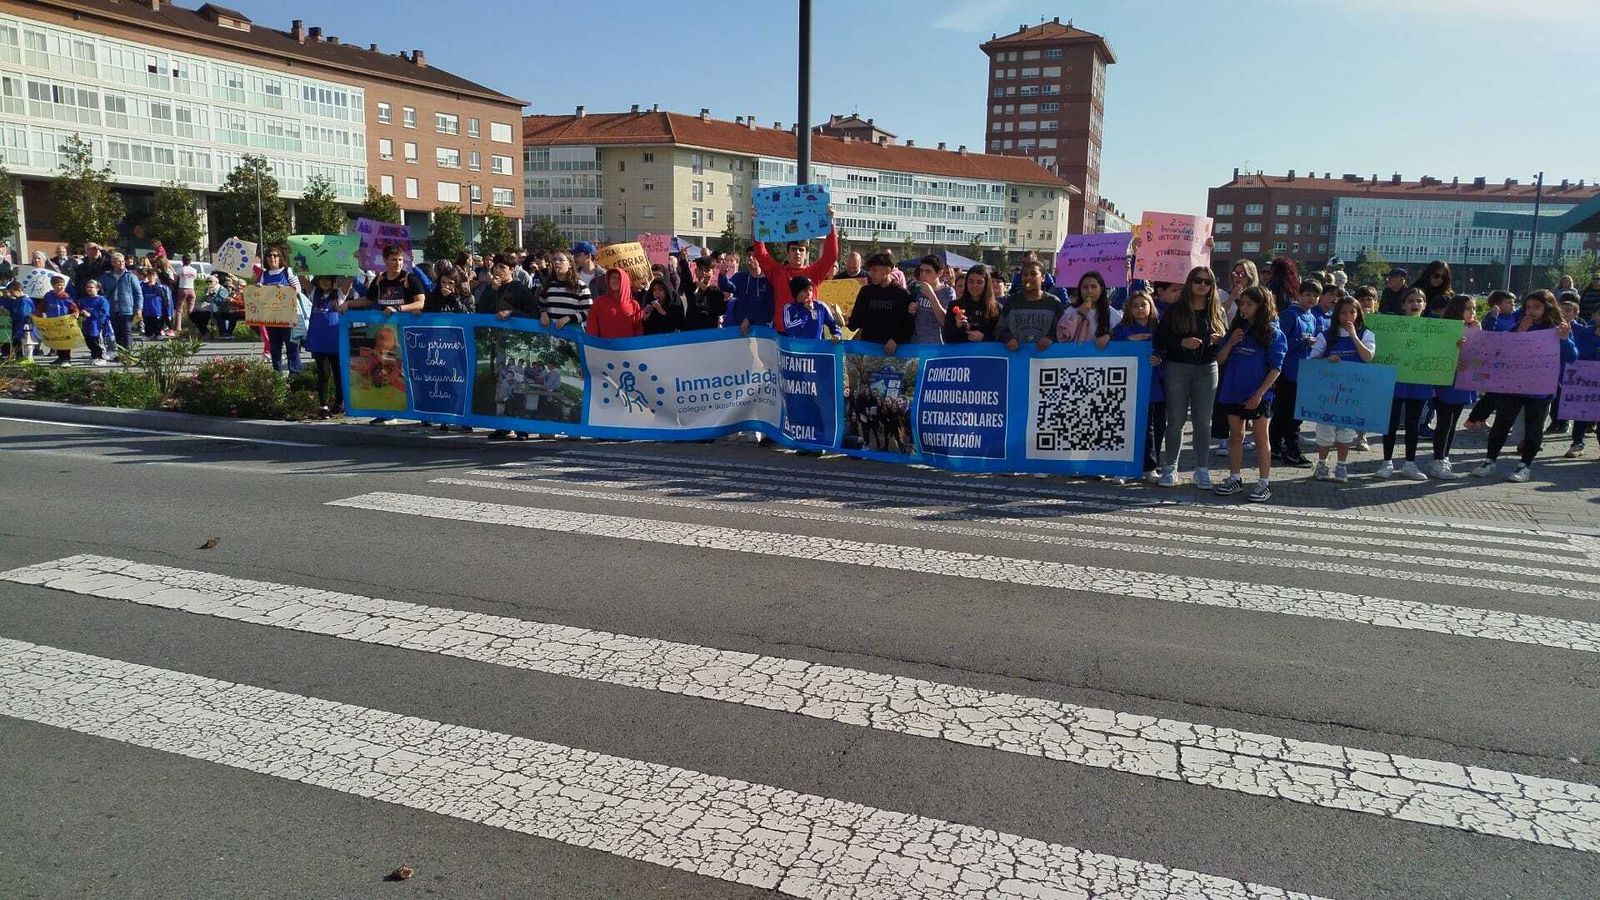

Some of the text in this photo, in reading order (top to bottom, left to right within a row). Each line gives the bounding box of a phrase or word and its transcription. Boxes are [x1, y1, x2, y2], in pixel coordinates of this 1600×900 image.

[406, 331, 465, 358] Tu primer
[425, 349, 447, 366] cole
[424, 367, 466, 393] segunda
[675, 368, 777, 392] Inmaculada
[927, 367, 970, 382] COMEDOR
[676, 384, 777, 404] concepción
[923, 389, 999, 405] MADRUGADORES
[677, 403, 707, 414] colegio
[922, 410, 1004, 428] EXTRAESCOLARES
[922, 431, 982, 448] ORIENTACIÓN
